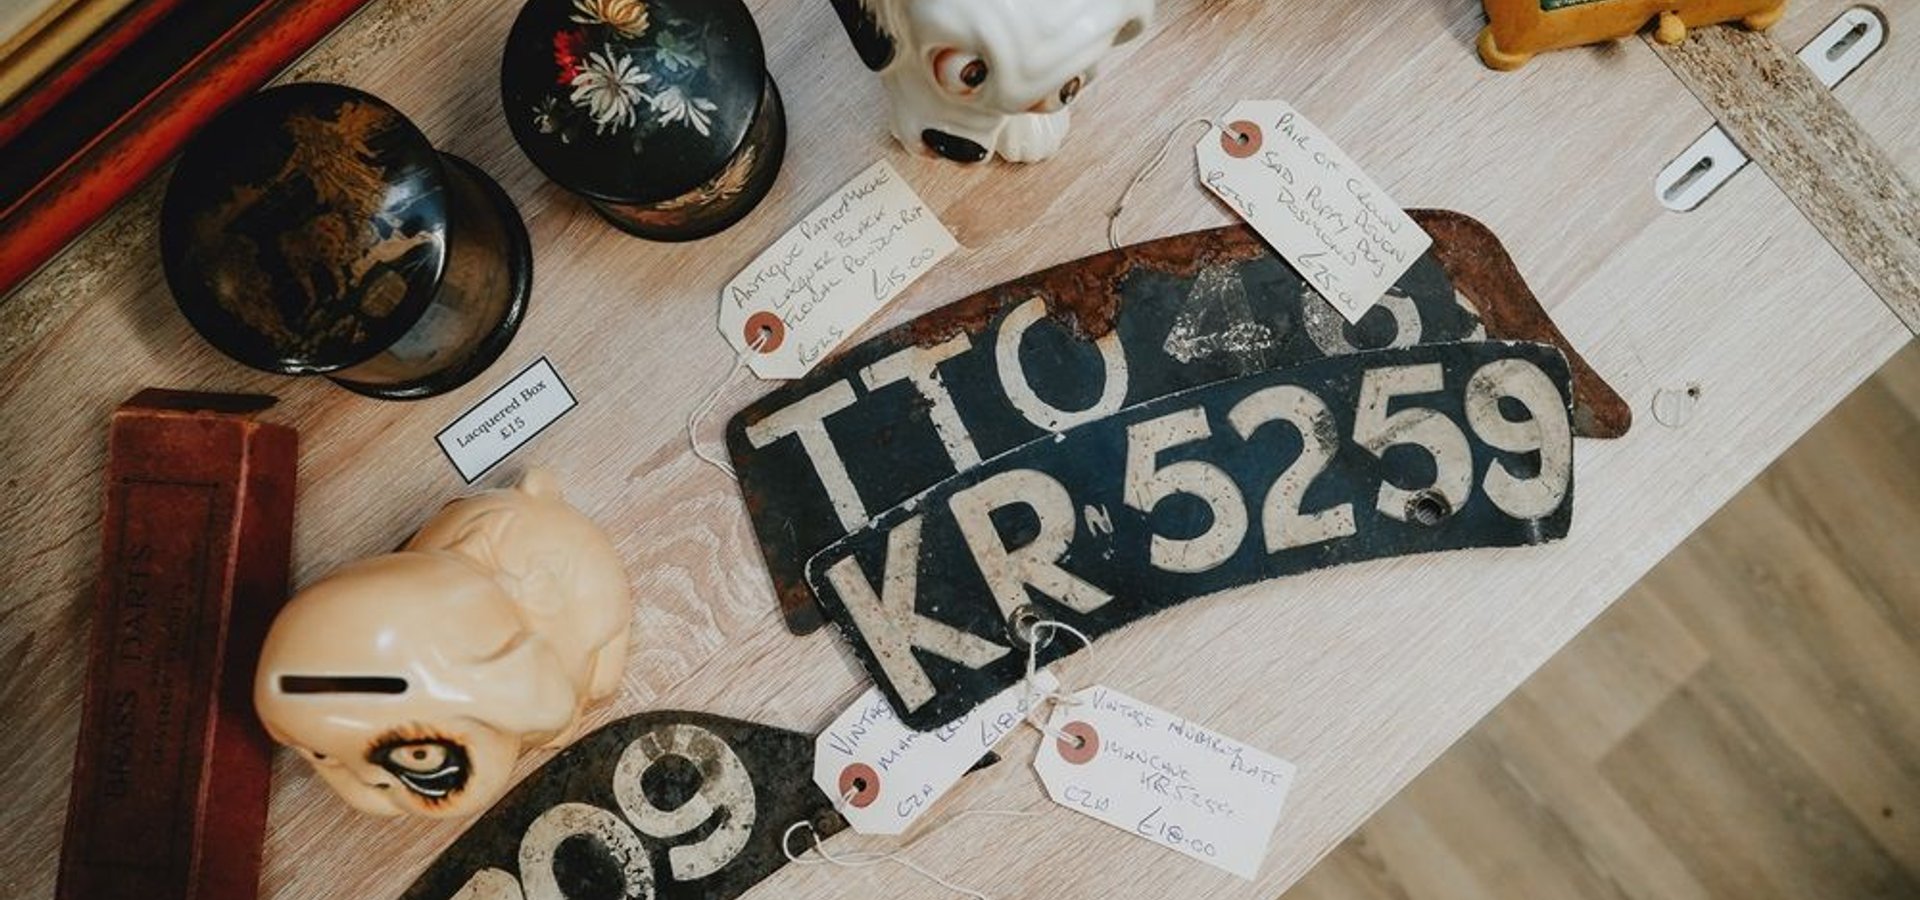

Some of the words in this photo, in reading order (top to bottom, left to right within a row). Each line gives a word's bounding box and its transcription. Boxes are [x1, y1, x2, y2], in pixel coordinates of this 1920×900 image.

[1263, 151, 1294, 185] SAD
[731, 246, 801, 309] ANTIQUE
[871, 247, 935, 301] £15.00
[456, 397, 521, 448] Lacquered
[520, 381, 547, 402] Box
[500, 417, 525, 440] £15
[745, 297, 1129, 533] TTO
[1123, 358, 1572, 573] 5259
[122, 543, 150, 663] DARTS
[1092, 690, 1153, 727] VINTAGE
[1137, 806, 1216, 857] £18.00
